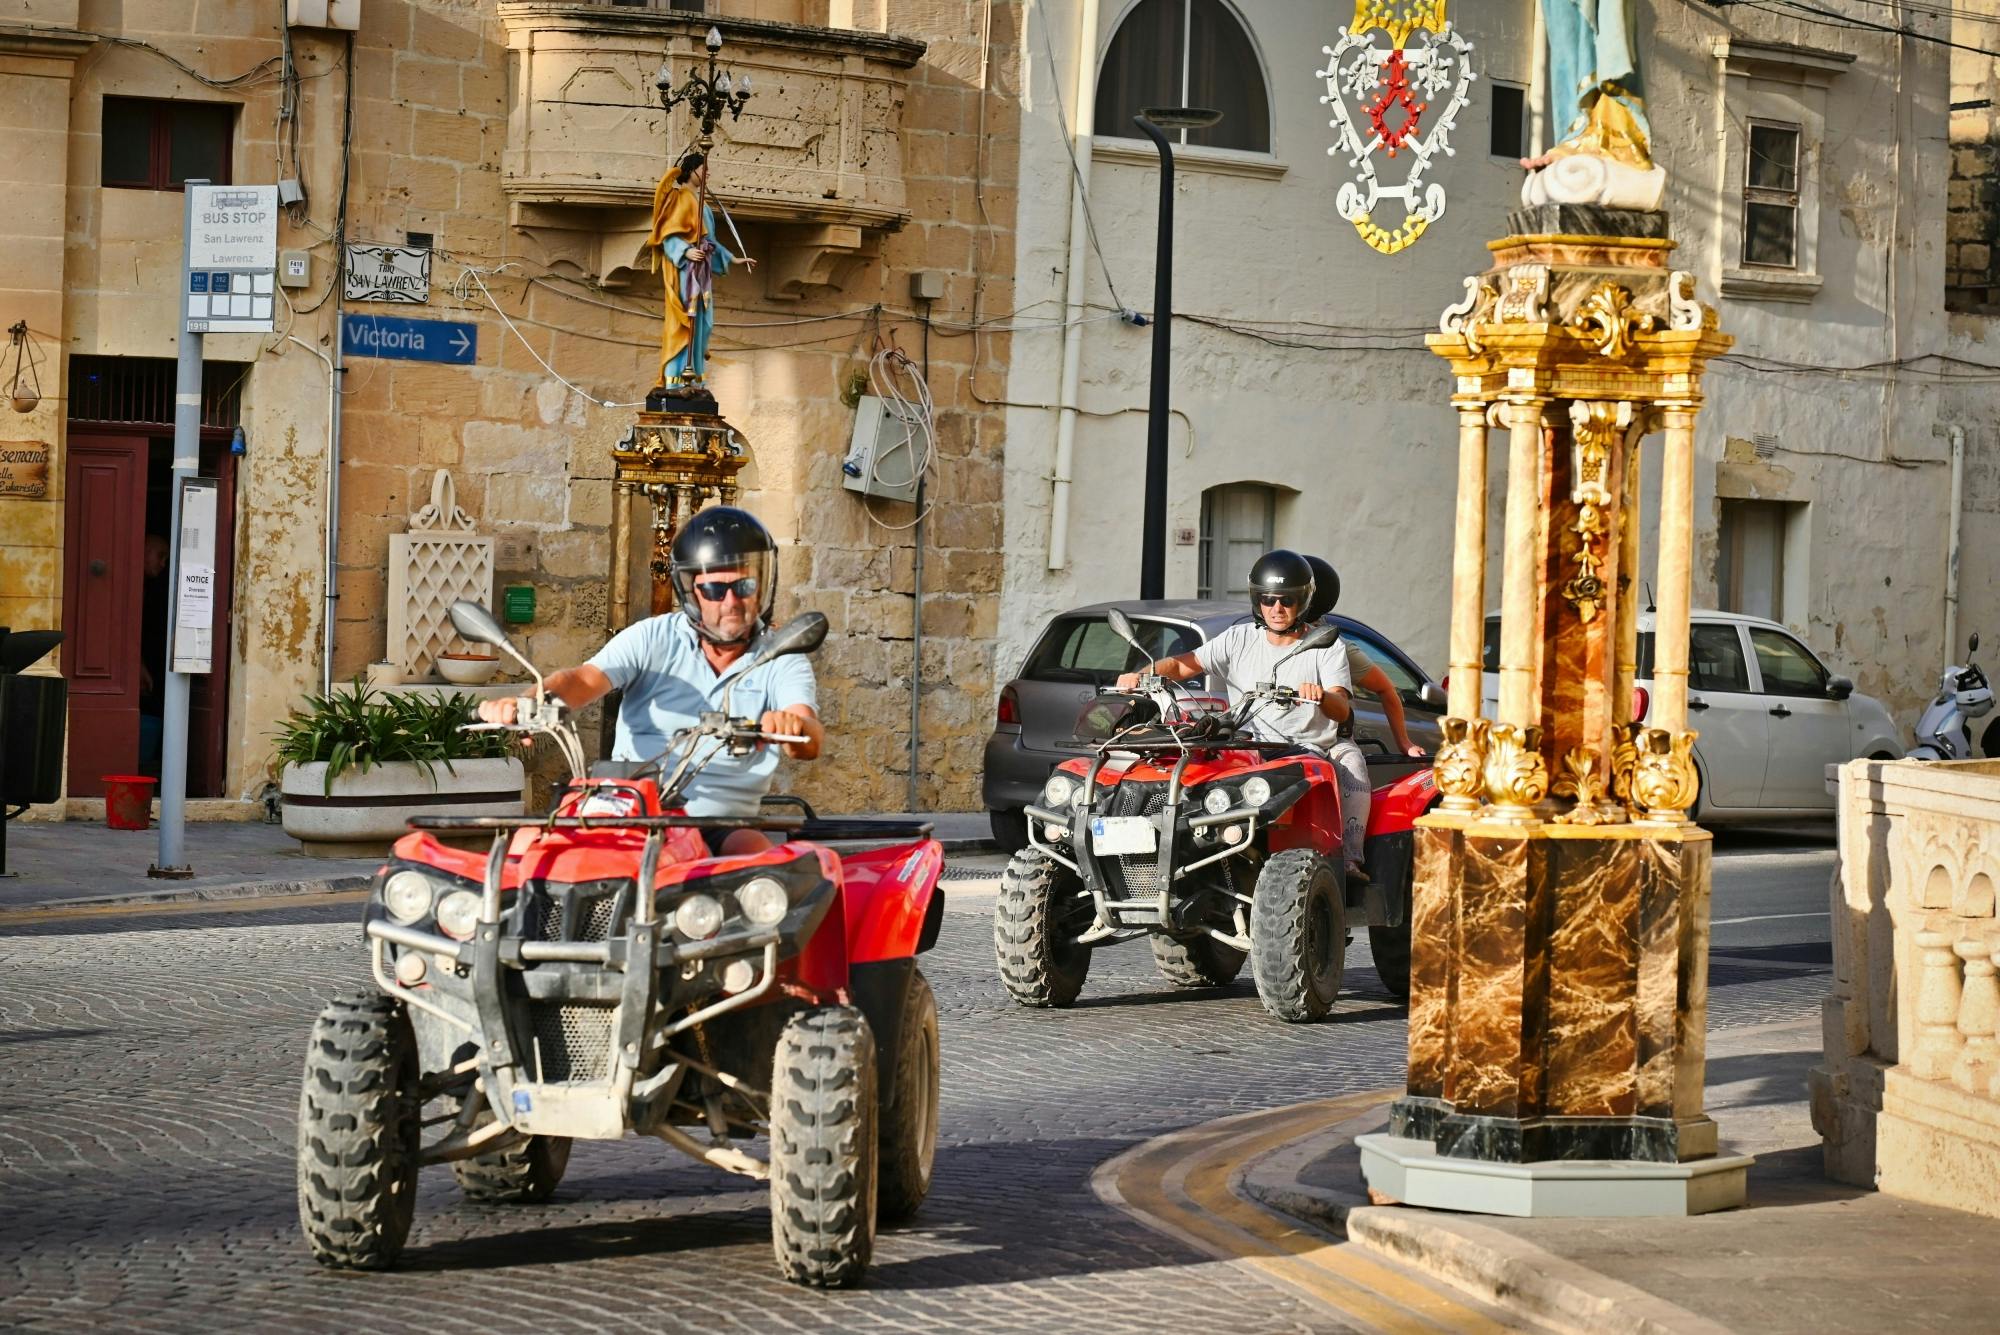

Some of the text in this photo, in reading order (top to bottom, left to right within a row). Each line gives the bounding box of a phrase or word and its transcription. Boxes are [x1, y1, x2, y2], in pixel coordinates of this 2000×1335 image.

[203, 212, 266, 224] BUS STOP
[204, 234, 265, 244] San Lawrenz
[212, 253, 255, 263] Lawrenz
[378, 264, 395, 274] TRIQ
[351, 275, 421, 290] SAN LAWRENZ
[189, 322, 208, 330] 1918
[348, 323, 425, 350] Victoria
[186, 575, 209, 584] NOTICE
